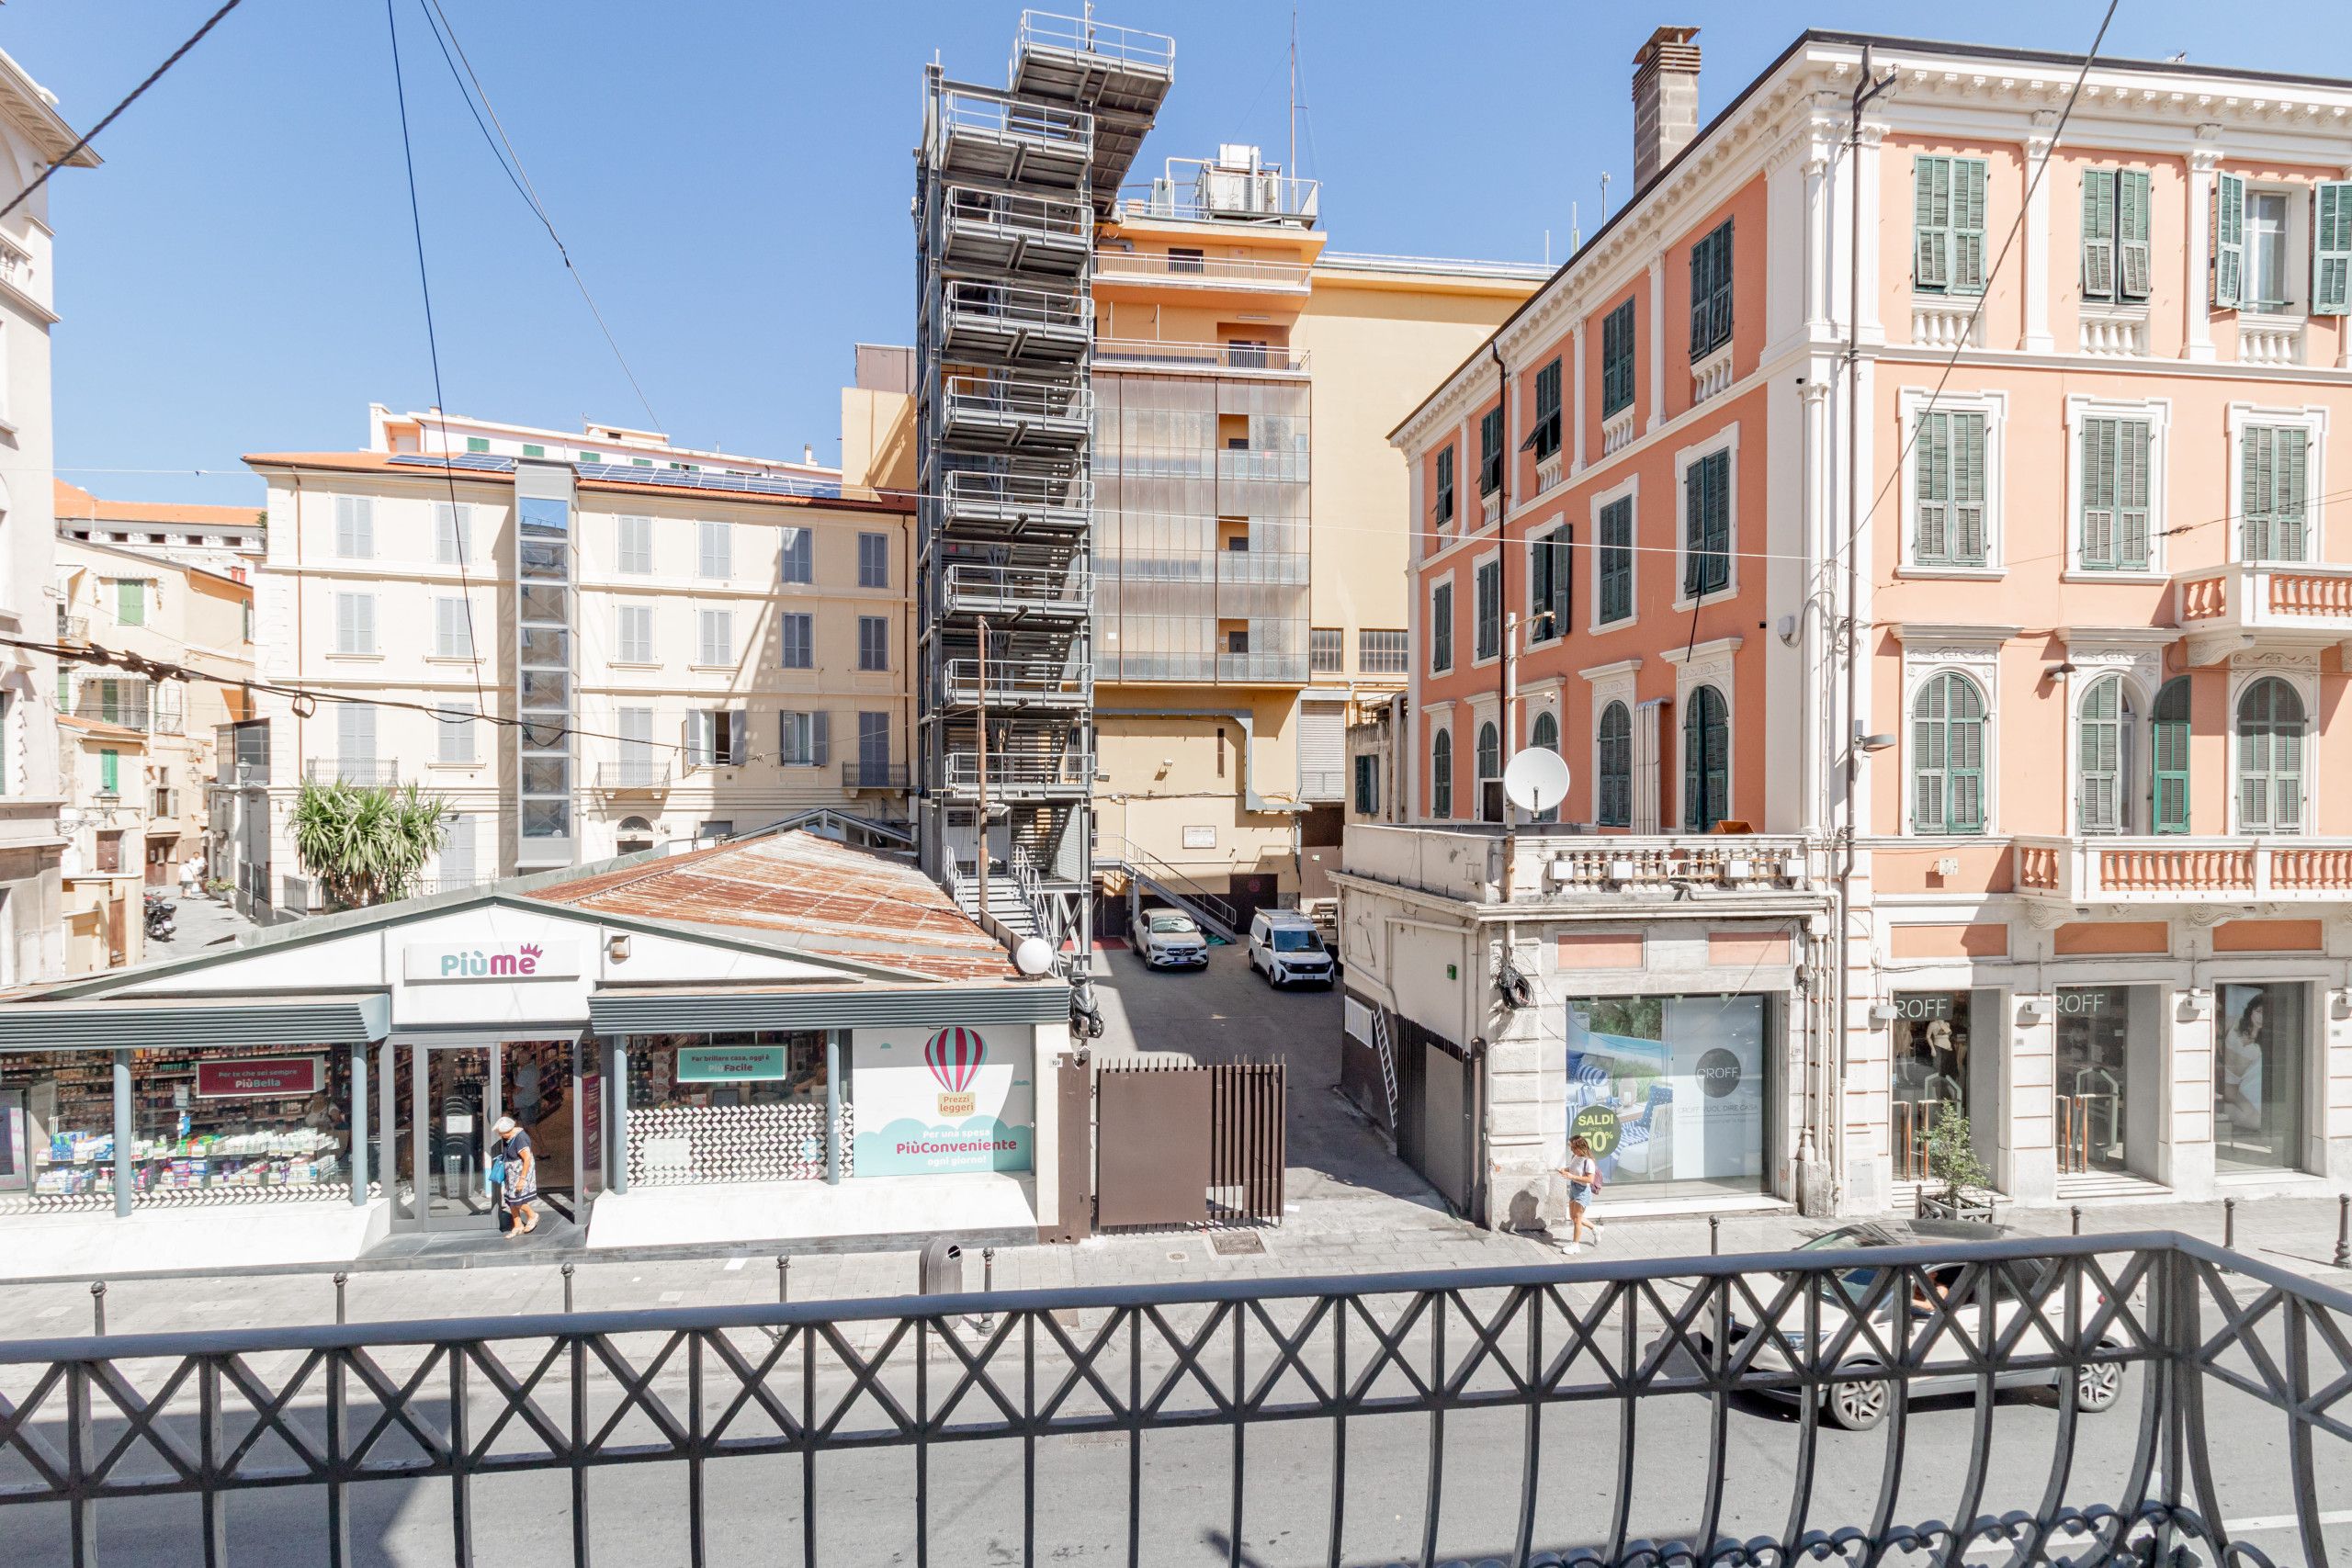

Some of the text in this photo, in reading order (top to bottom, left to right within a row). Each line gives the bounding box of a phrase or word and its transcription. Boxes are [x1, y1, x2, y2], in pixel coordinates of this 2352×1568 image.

[749, 1054, 764, 1063] oggi
[242, 1069, 256, 1077] che
[257, 1068, 268, 1077] sei
[269, 1067, 298, 1077] sempre
[1696, 1066, 1738, 1079] CROFF
[235, 1078, 281, 1089] PiùBella
[944, 1095, 970, 1103] Prezzi
[940, 1102, 974, 1113] leggeri
[1577, 1113, 1614, 1126] SALDI
[922, 1130, 938, 1138] Per
[961, 1129, 990, 1138] spesa
[896, 1139, 1017, 1155] PiùConveniente
[927, 1156, 987, 1168] ogni giorno!
